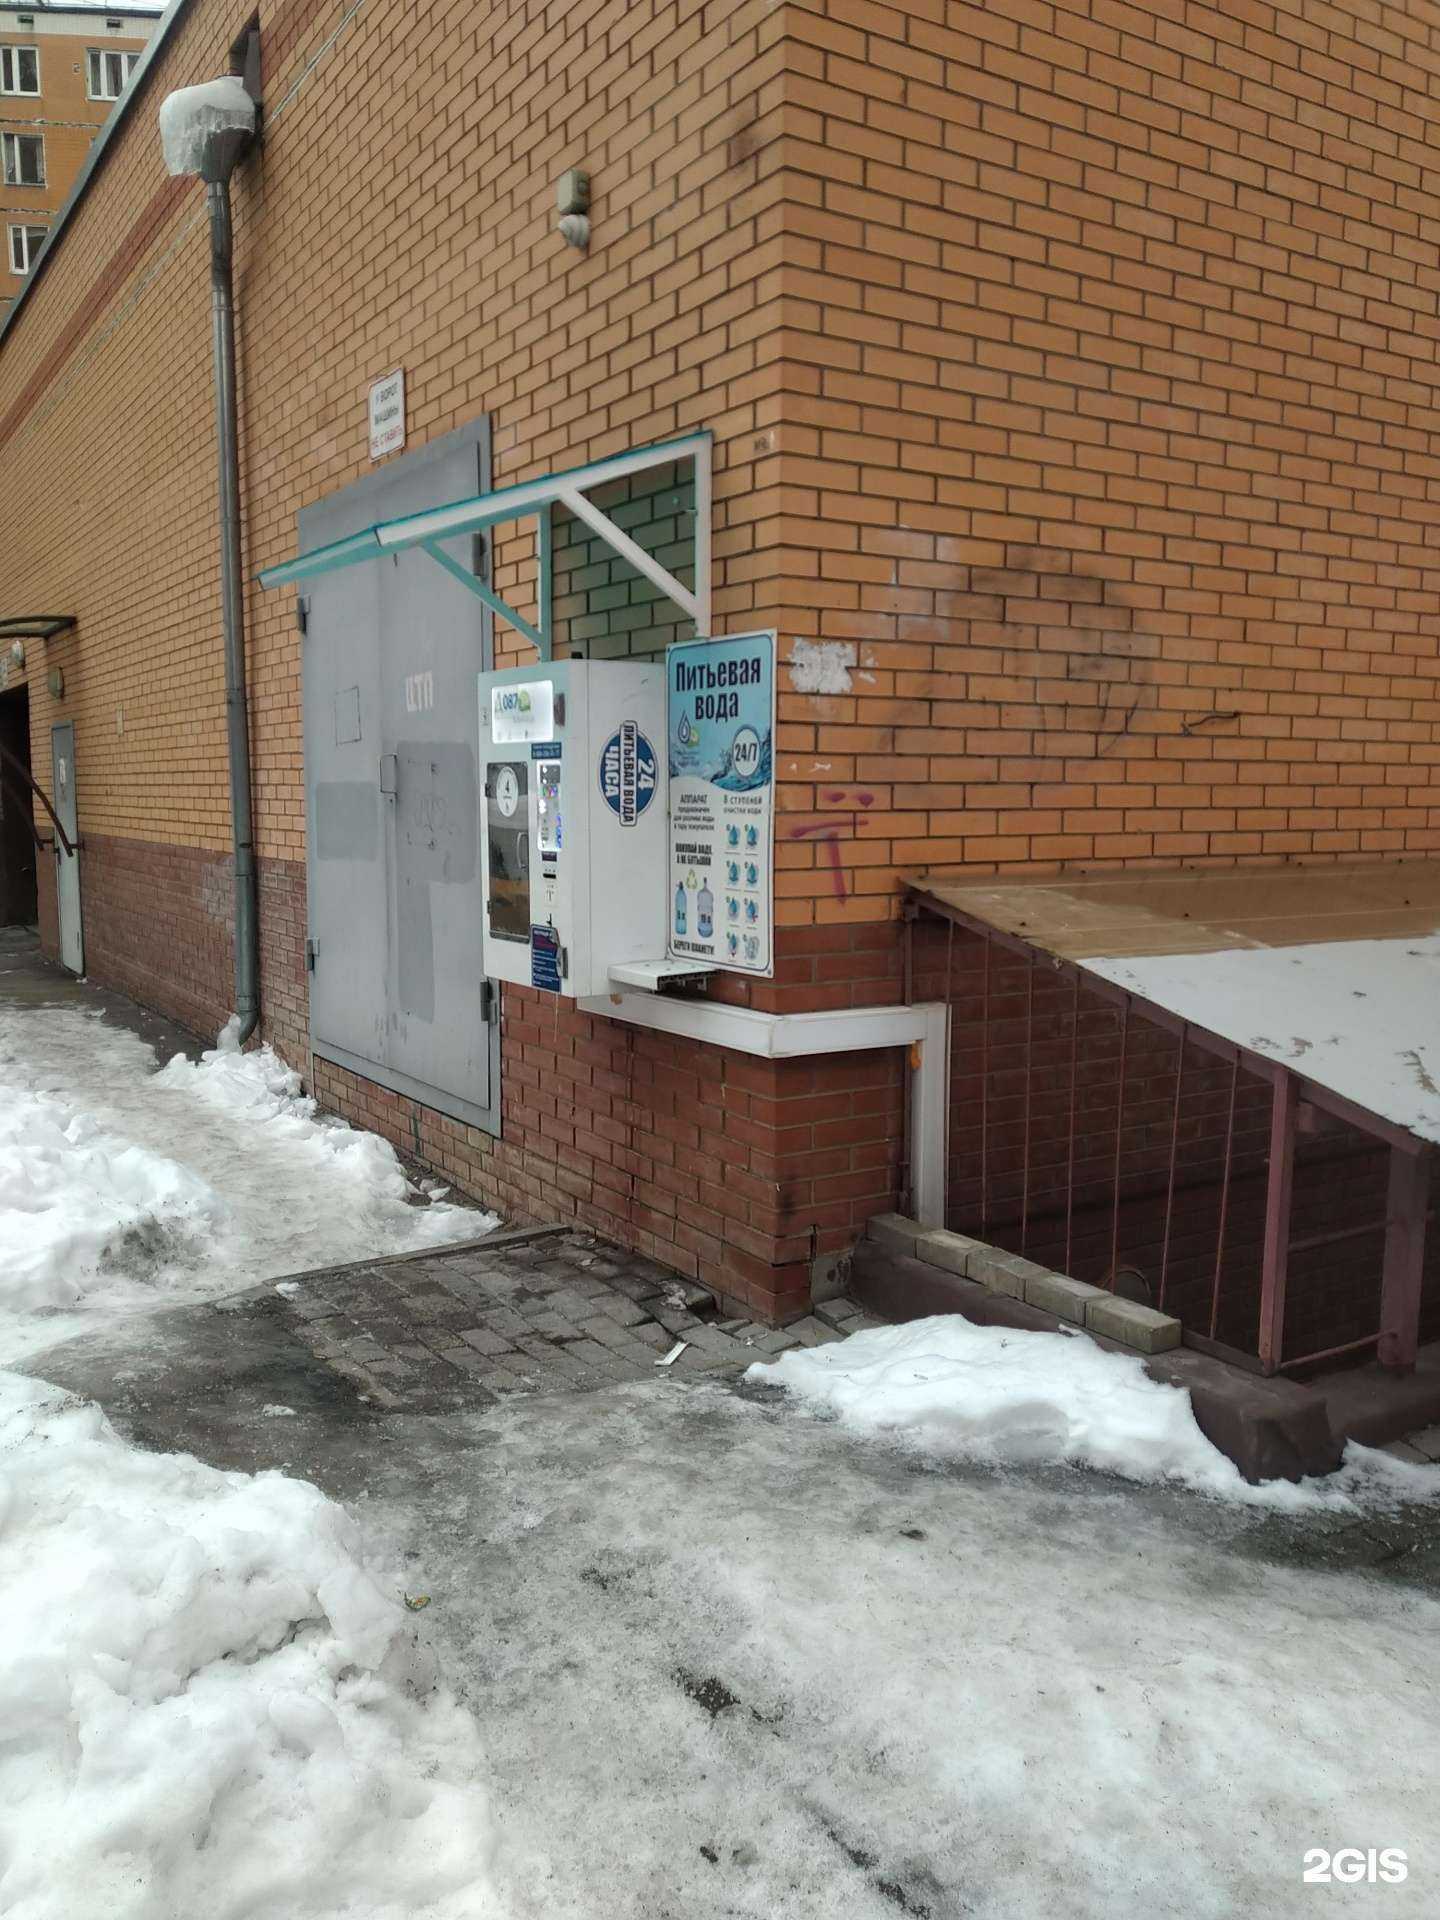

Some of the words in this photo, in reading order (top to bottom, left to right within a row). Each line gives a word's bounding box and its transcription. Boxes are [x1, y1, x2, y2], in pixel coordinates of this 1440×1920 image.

[374, 404, 399, 425] МАШИНЫ
[676, 657, 761, 692] Питьевая
[695, 692, 739, 723] вода
[623, 724, 635, 786] ПИТЬЕВАЯ
[735, 743, 758, 762] 24/7
[605, 745, 620, 798] ЧАСА
[638, 758, 655, 790] 24
[623, 789, 634, 823] ВОДА
[680, 794, 708, 805] АППАРАТ
